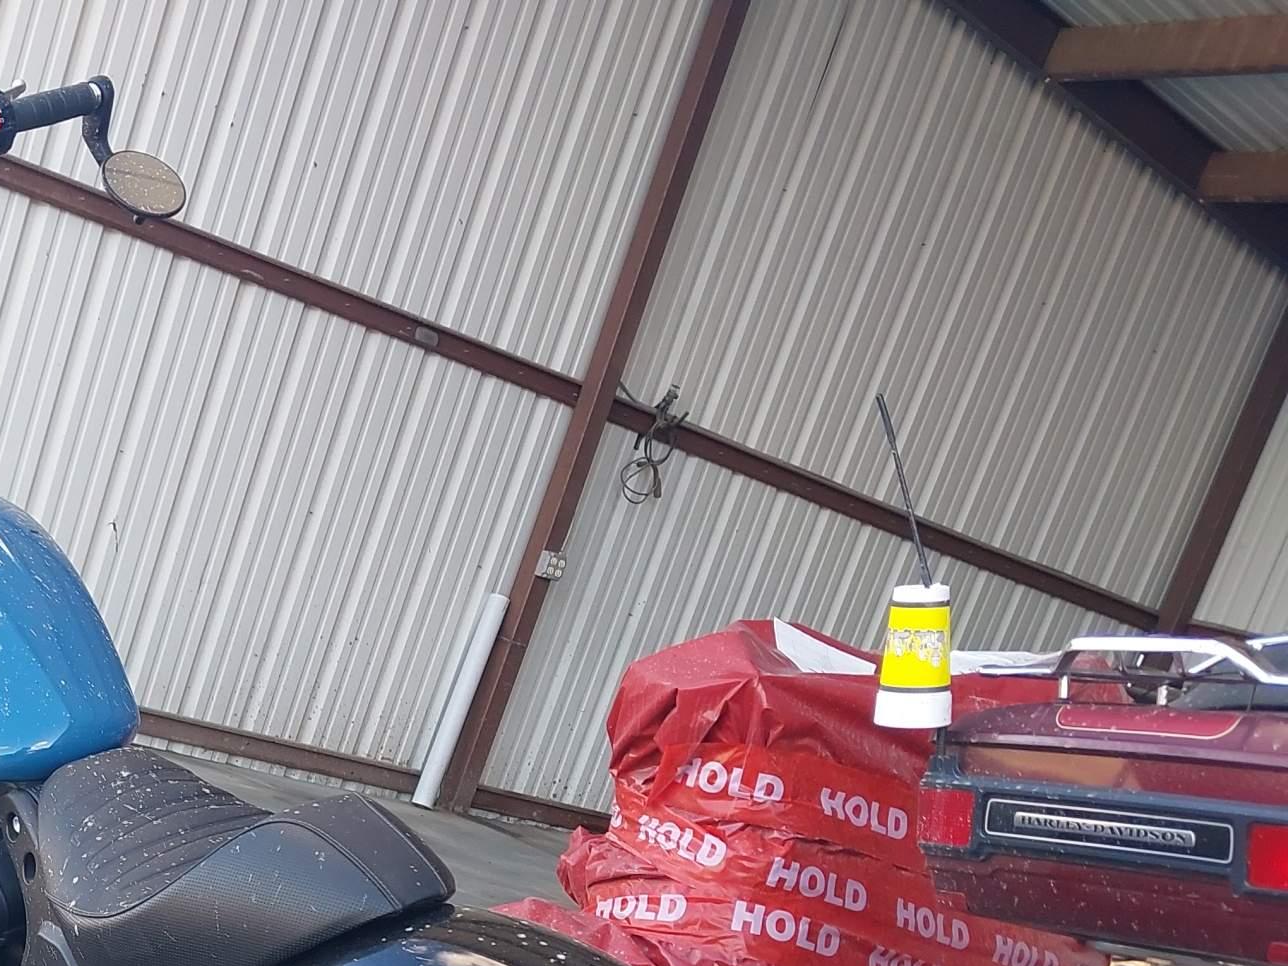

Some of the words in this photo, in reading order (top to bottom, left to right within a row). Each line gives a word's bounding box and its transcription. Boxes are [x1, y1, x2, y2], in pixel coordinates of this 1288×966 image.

[676, 758, 785, 803] HOLD
[820, 787, 908, 840] HOLD
[1020, 814, 1188, 845] HARLEY-DAVIDSON
[638, 815, 727, 867] HOLD
[766, 856, 867, 912] HOLD
[896, 897, 970, 949] HOLD
[595, 894, 687, 922] HOLD
[731, 900, 840, 957] HOLD
